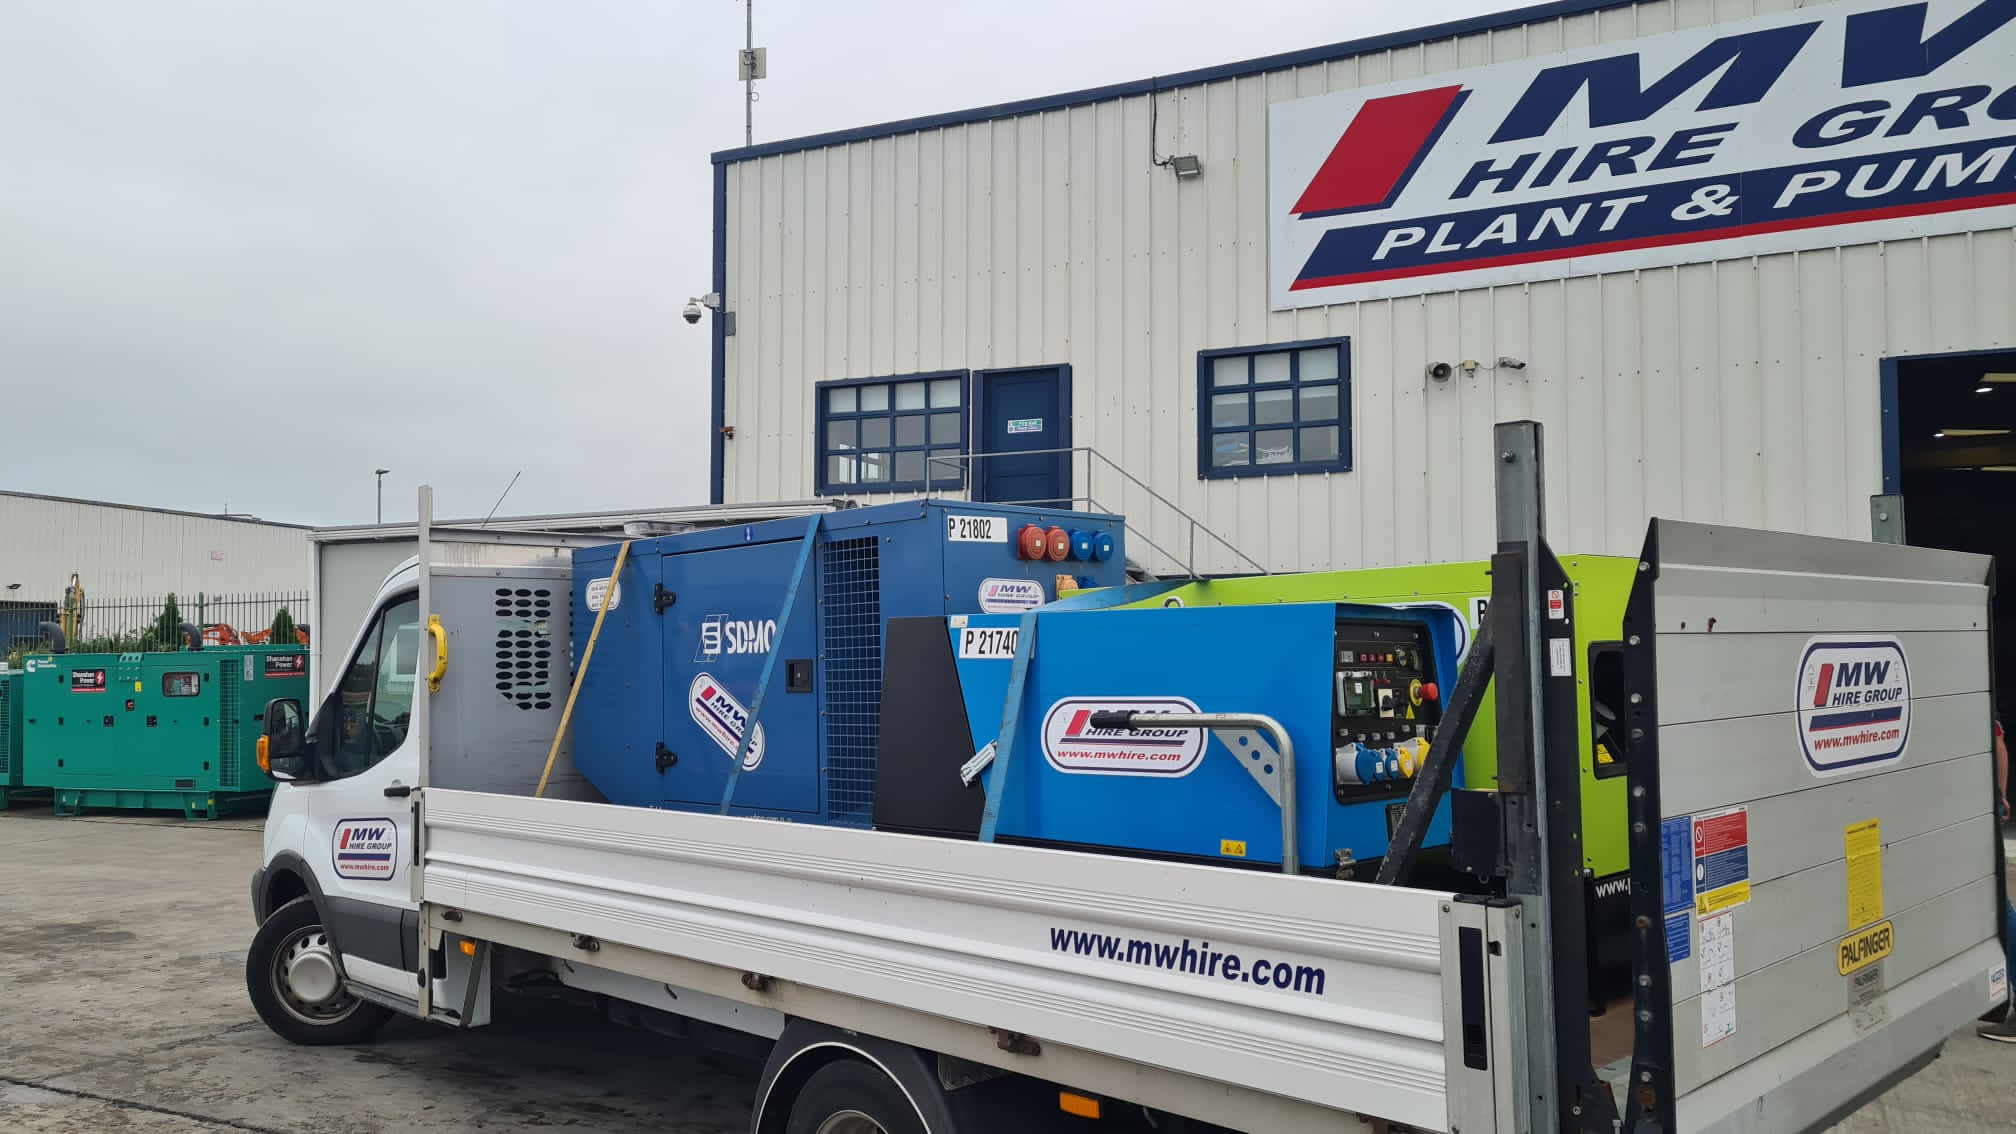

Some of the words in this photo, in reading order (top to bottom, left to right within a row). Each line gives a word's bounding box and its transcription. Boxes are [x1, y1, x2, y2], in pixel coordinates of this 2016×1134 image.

[1448, 122, 1740, 200] HIRE
[1372, 195, 1648, 261] PLANT
[1671, 184, 1740, 220] &
[1773, 146, 2016, 208] PUM
[949, 518, 956, 538] P
[960, 518, 992, 539] 21802
[1000, 584, 1031, 593] MW
[725, 619, 776, 654] SDMO
[965, 630, 974, 654] P
[979, 630, 1019, 655] 21740
[1836, 660, 1892, 688] MW
[1832, 691, 1862, 706] HIRE
[1864, 688, 1903, 703] GROUP
[710, 702, 730, 720] HIRE
[1085, 728, 1124, 736] HIRE
[1129, 729, 1188, 737] GROUP
[1814, 729, 1900, 751] www.mwhire.com
[1057, 750, 1181, 761] www.mwhire.com
[351, 828, 386, 840] MW
[367, 842, 392, 850] GROUP
[1841, 927, 1891, 969] PALFINGER
[1050, 927, 1325, 995] www.mwhire.com
